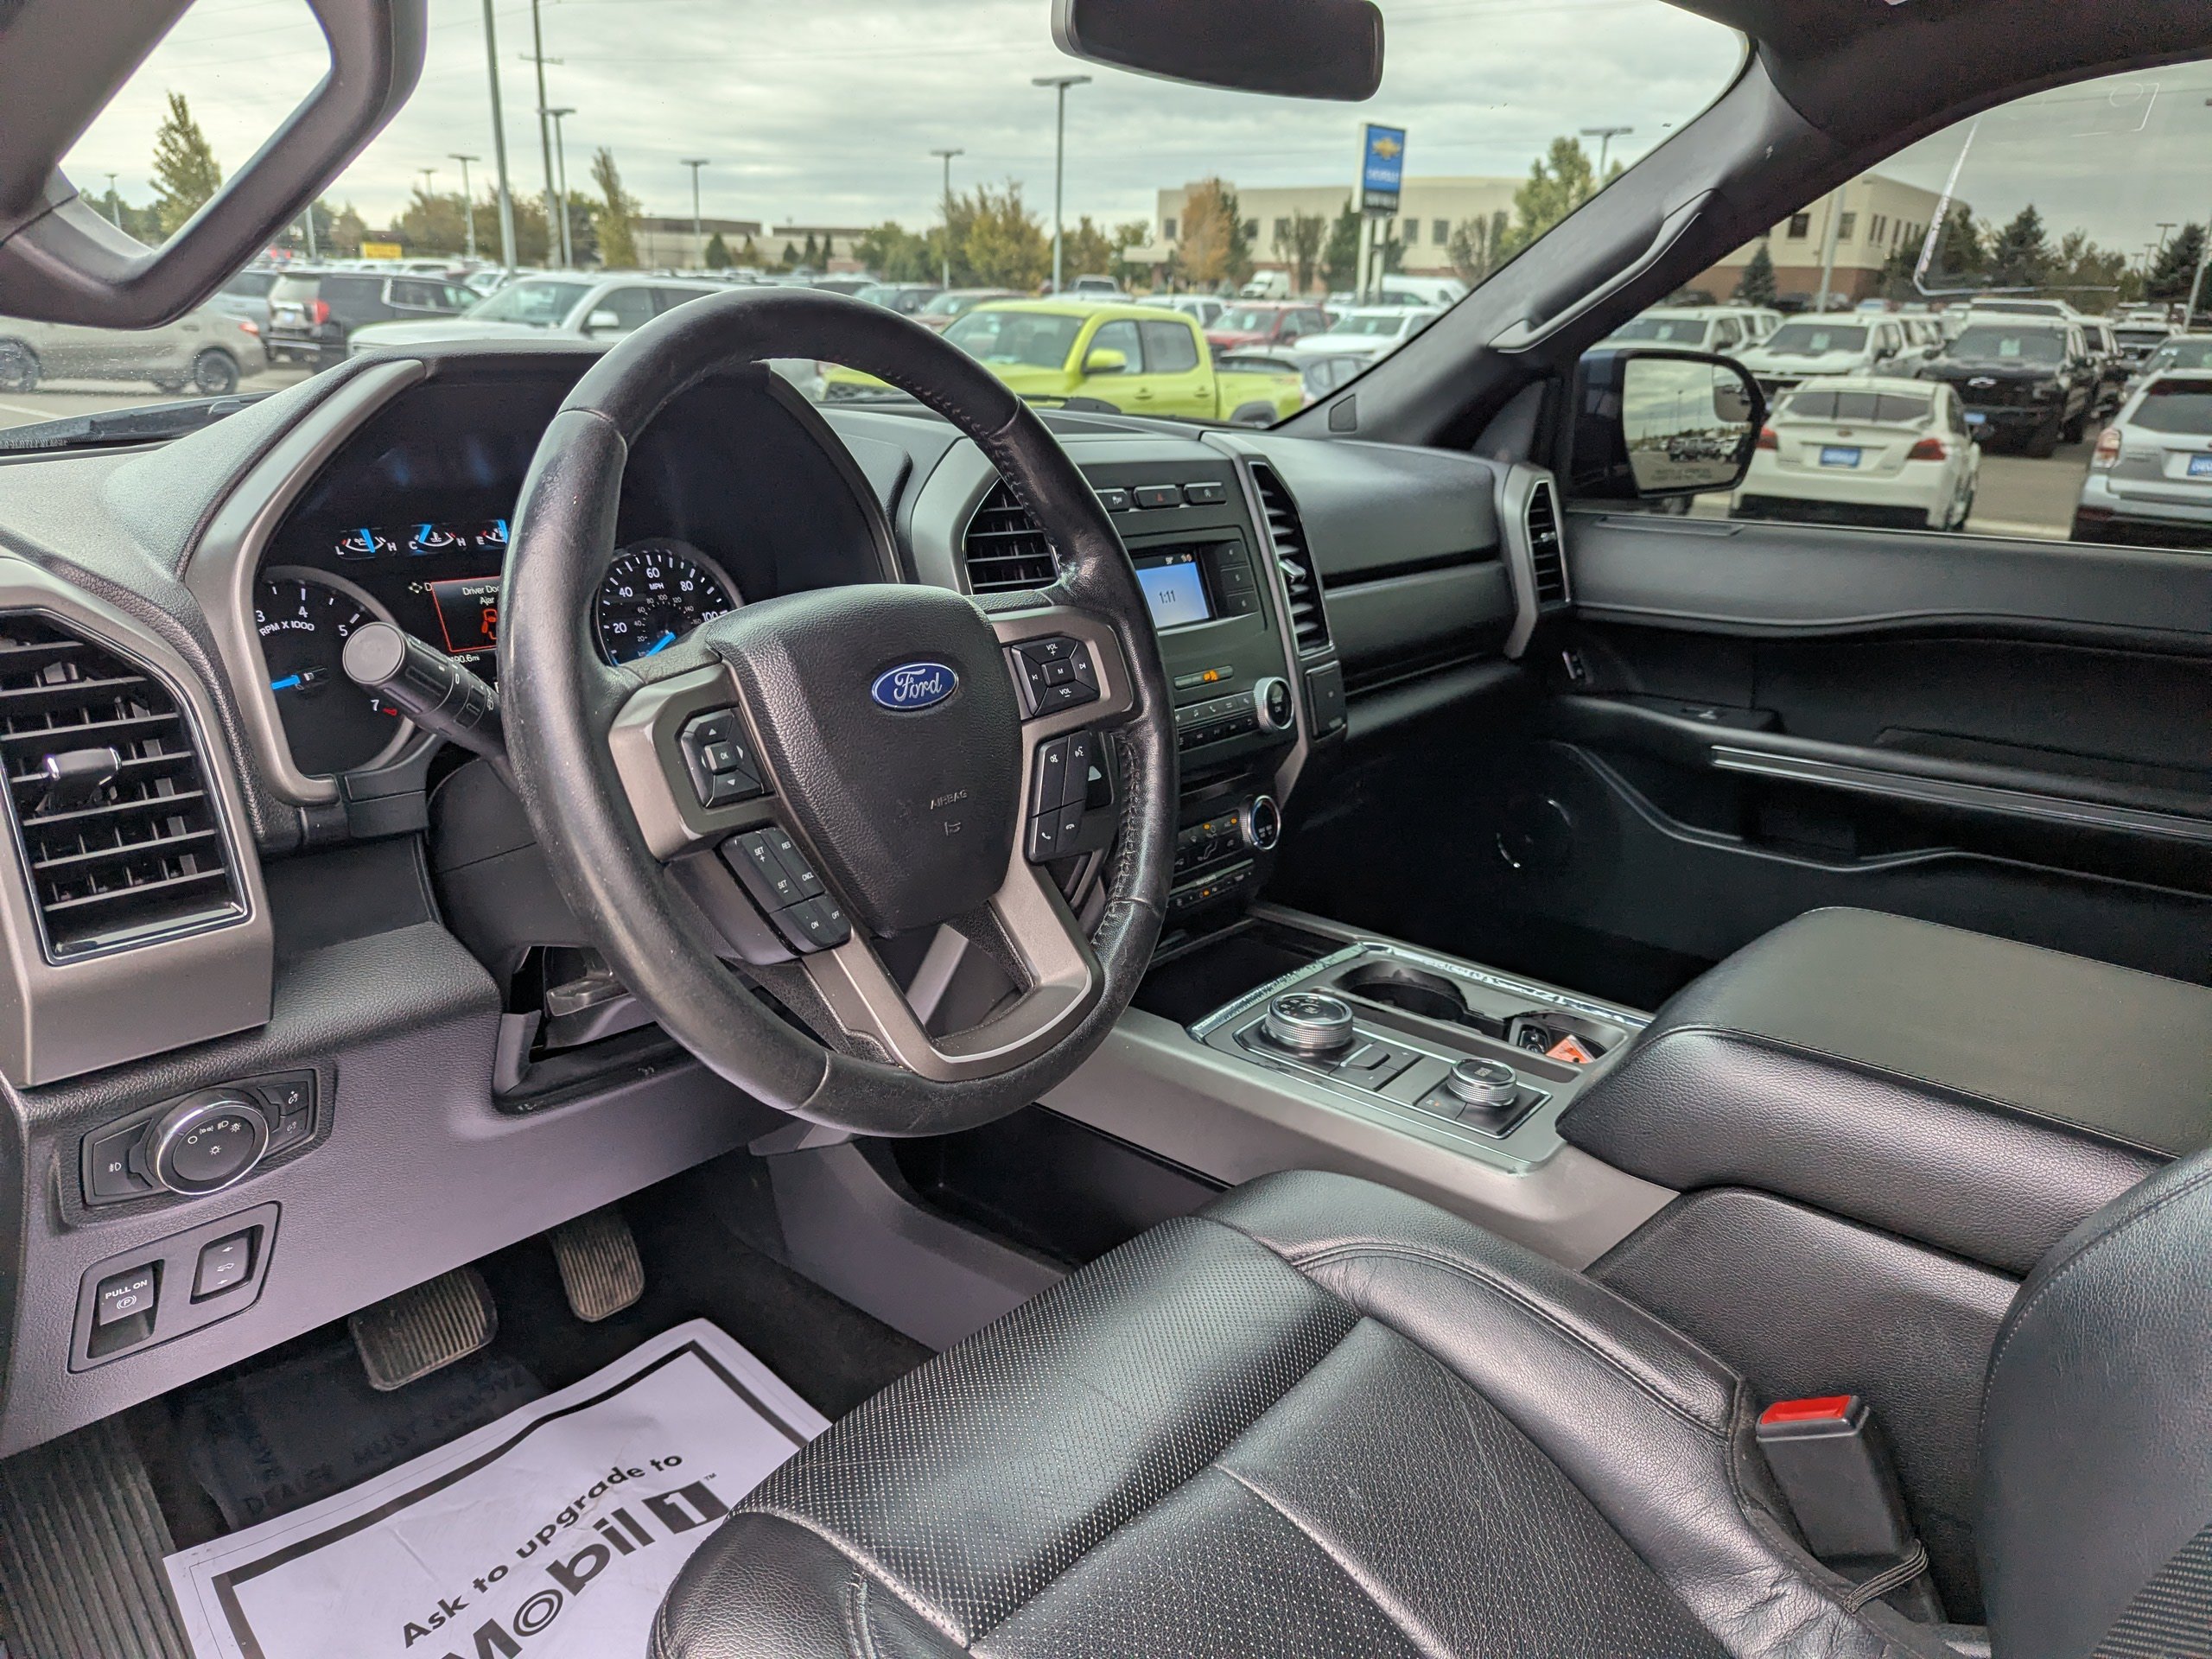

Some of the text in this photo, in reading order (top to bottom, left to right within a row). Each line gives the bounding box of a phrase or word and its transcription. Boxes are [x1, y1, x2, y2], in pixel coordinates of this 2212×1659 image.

[408, 540, 417, 550] C
[456, 537, 467, 547] H
[476, 535, 485, 545] E
[387, 542, 397, 552] H
[646, 567, 660, 579] 60
[462, 587, 485, 595] Driver
[619, 586, 633, 597] 40
[649, 582, 664, 590] MPH
[679, 580, 694, 592] 80
[480, 596, 495, 606] Ajar
[1159, 589, 1176, 604] 1:11
[255, 609, 266, 622] 3
[298, 606, 308, 618] 4
[259, 620, 315, 636] RPM X 1000
[338, 624, 348, 637] 5
[613, 621, 627, 633] 20
[1046, 643, 1058, 652] VOL
[893, 668, 943, 702] Ford
[370, 699, 380, 711] 7
[720, 752, 728, 760] OK
[781, 841, 791, 850] RES
[754, 846, 765, 857] SET
[801, 872, 814, 881] CNCL
[778, 879, 788, 889] SET
[831, 910, 841, 920] OFF
[810, 920, 820, 930] ON
[105, 1280, 148, 1300] PULL ON
[402, 1454, 683, 1649] Ask to upgrade to
[442, 1506, 656, 1659] Mobil
